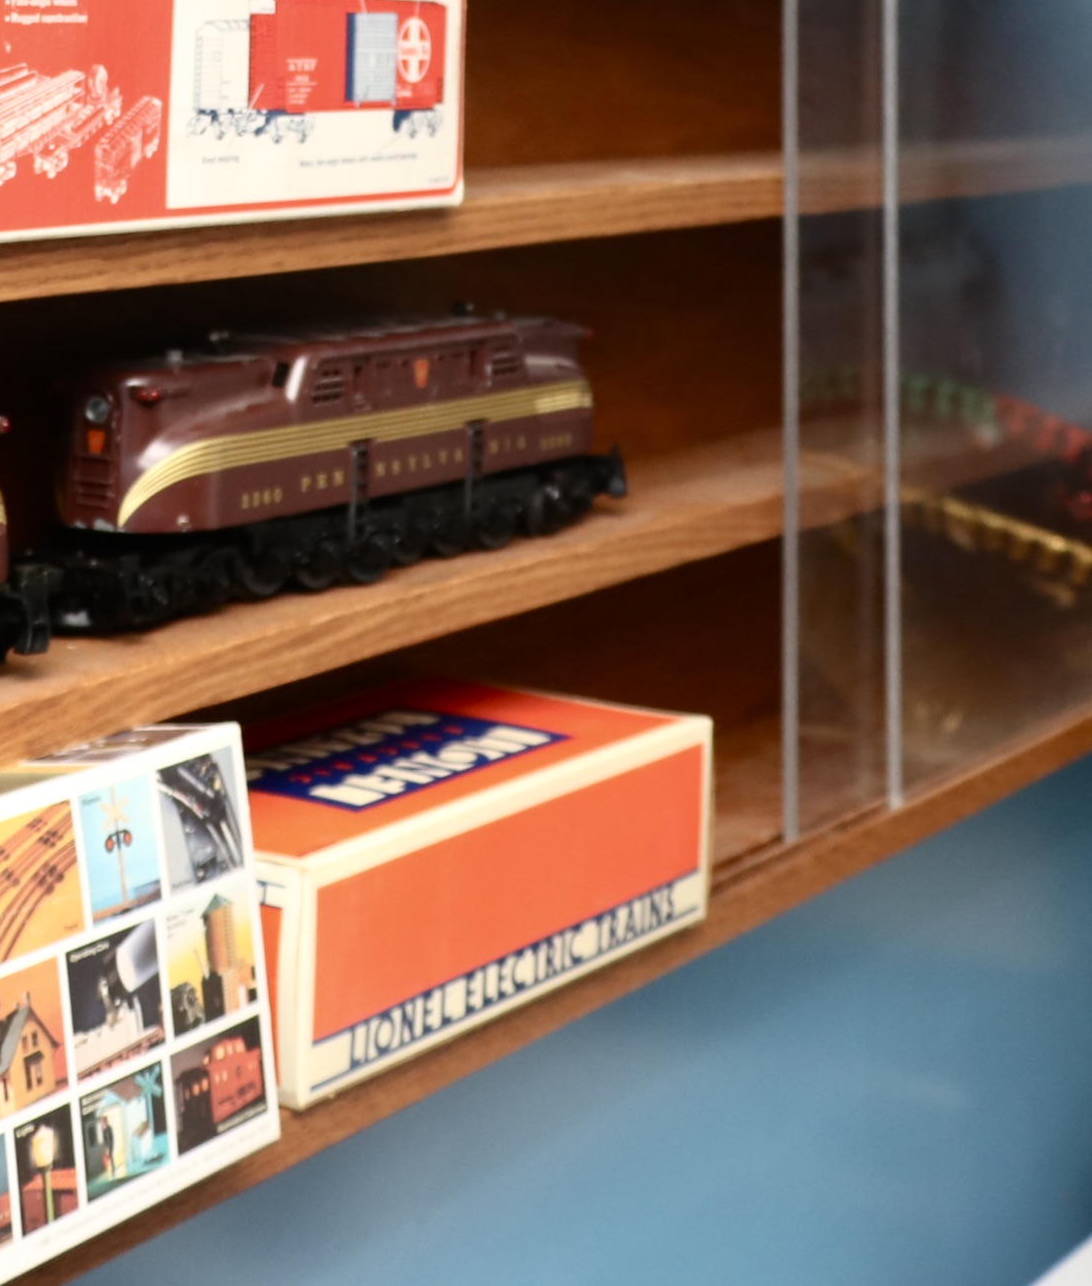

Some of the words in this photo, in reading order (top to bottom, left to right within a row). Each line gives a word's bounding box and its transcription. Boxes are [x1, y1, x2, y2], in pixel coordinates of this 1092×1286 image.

[300, 438, 528, 494] PENNSYLVANIA
[350, 977, 466, 1071] LIONEL
[464, 919, 593, 1024] ELECTRIC
[595, 884, 676, 956] TRAINS
